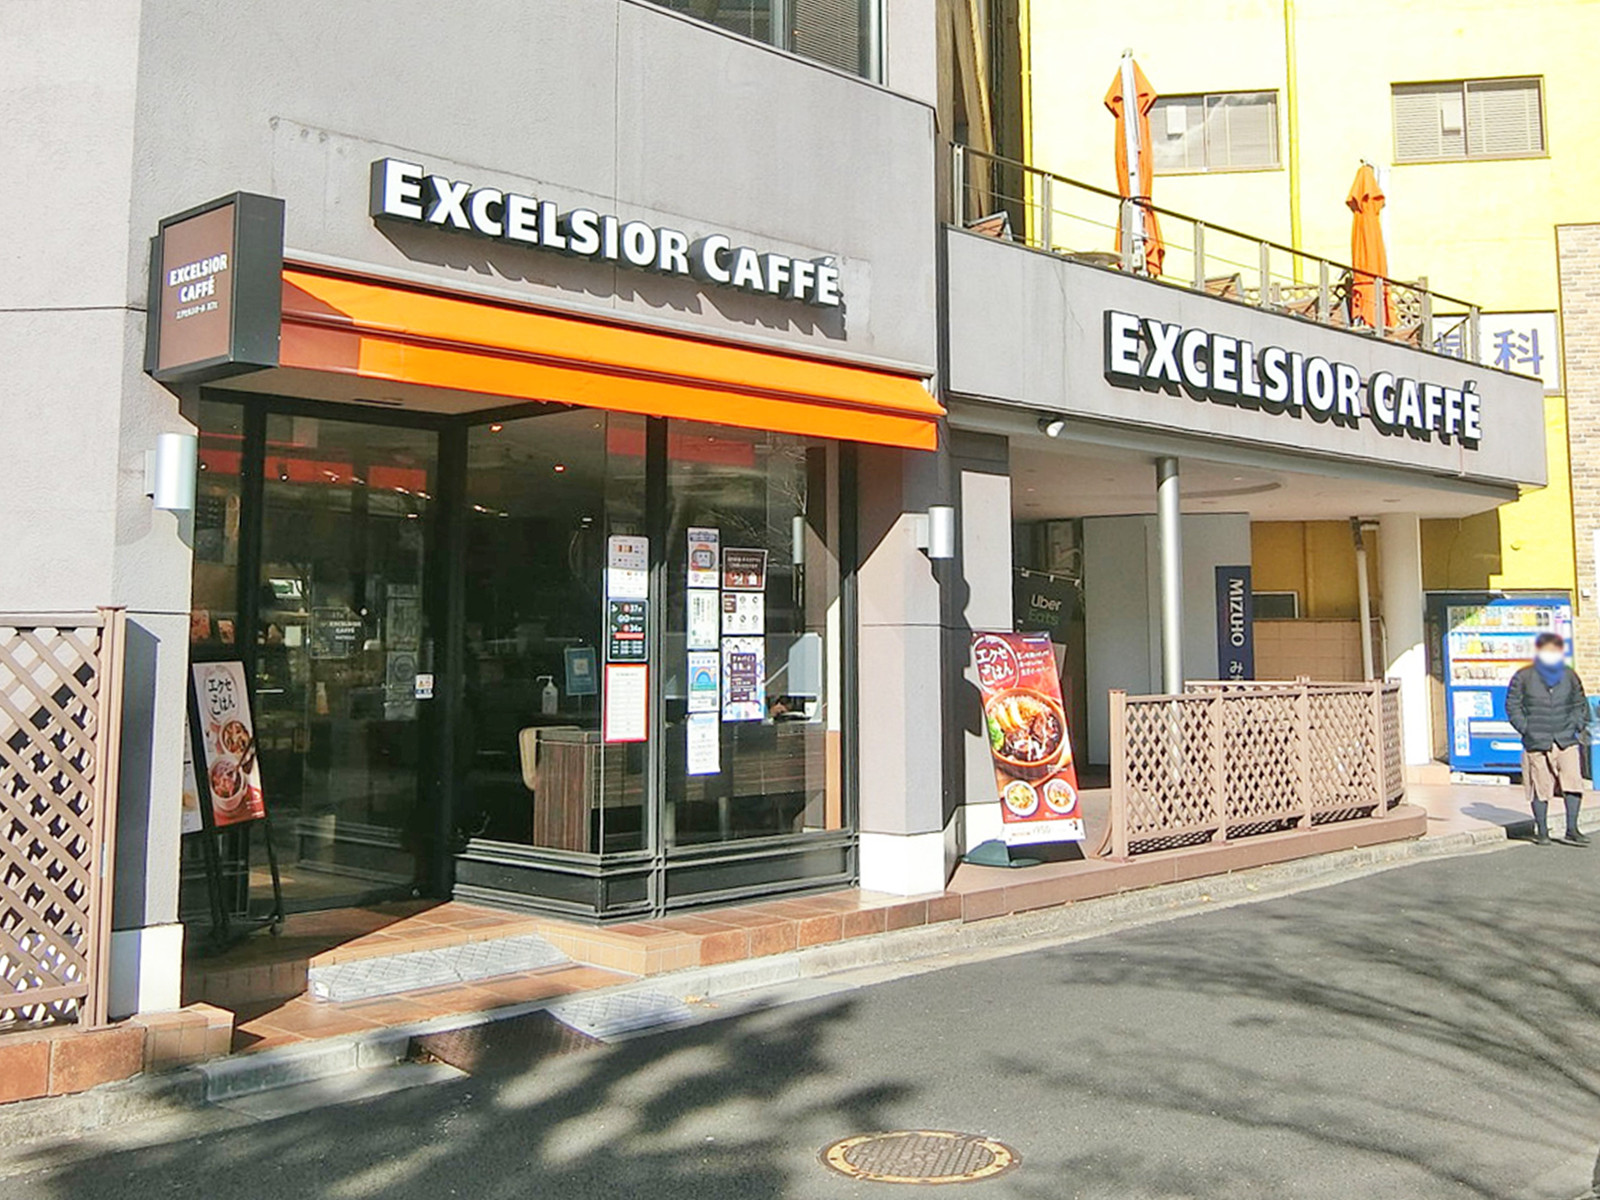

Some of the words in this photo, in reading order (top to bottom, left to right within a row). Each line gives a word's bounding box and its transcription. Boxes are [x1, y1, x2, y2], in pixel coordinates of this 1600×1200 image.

[382, 158, 690, 275] EXCELSIOR
[701, 234, 840, 306] CAFFÉ
[168, 253, 228, 287] EXCELSIOR
[180, 275, 215, 303] CAFFÉ
[1107, 310, 1362, 418] EXCELSIOR
[1372, 372, 1483, 441] CAFFÉ
[1030, 594, 1062, 611] Uber
[1229, 578, 1245, 647] MIZUHO
[208, 678, 232, 694] エクセ
[210, 694, 236, 716] ごはん
